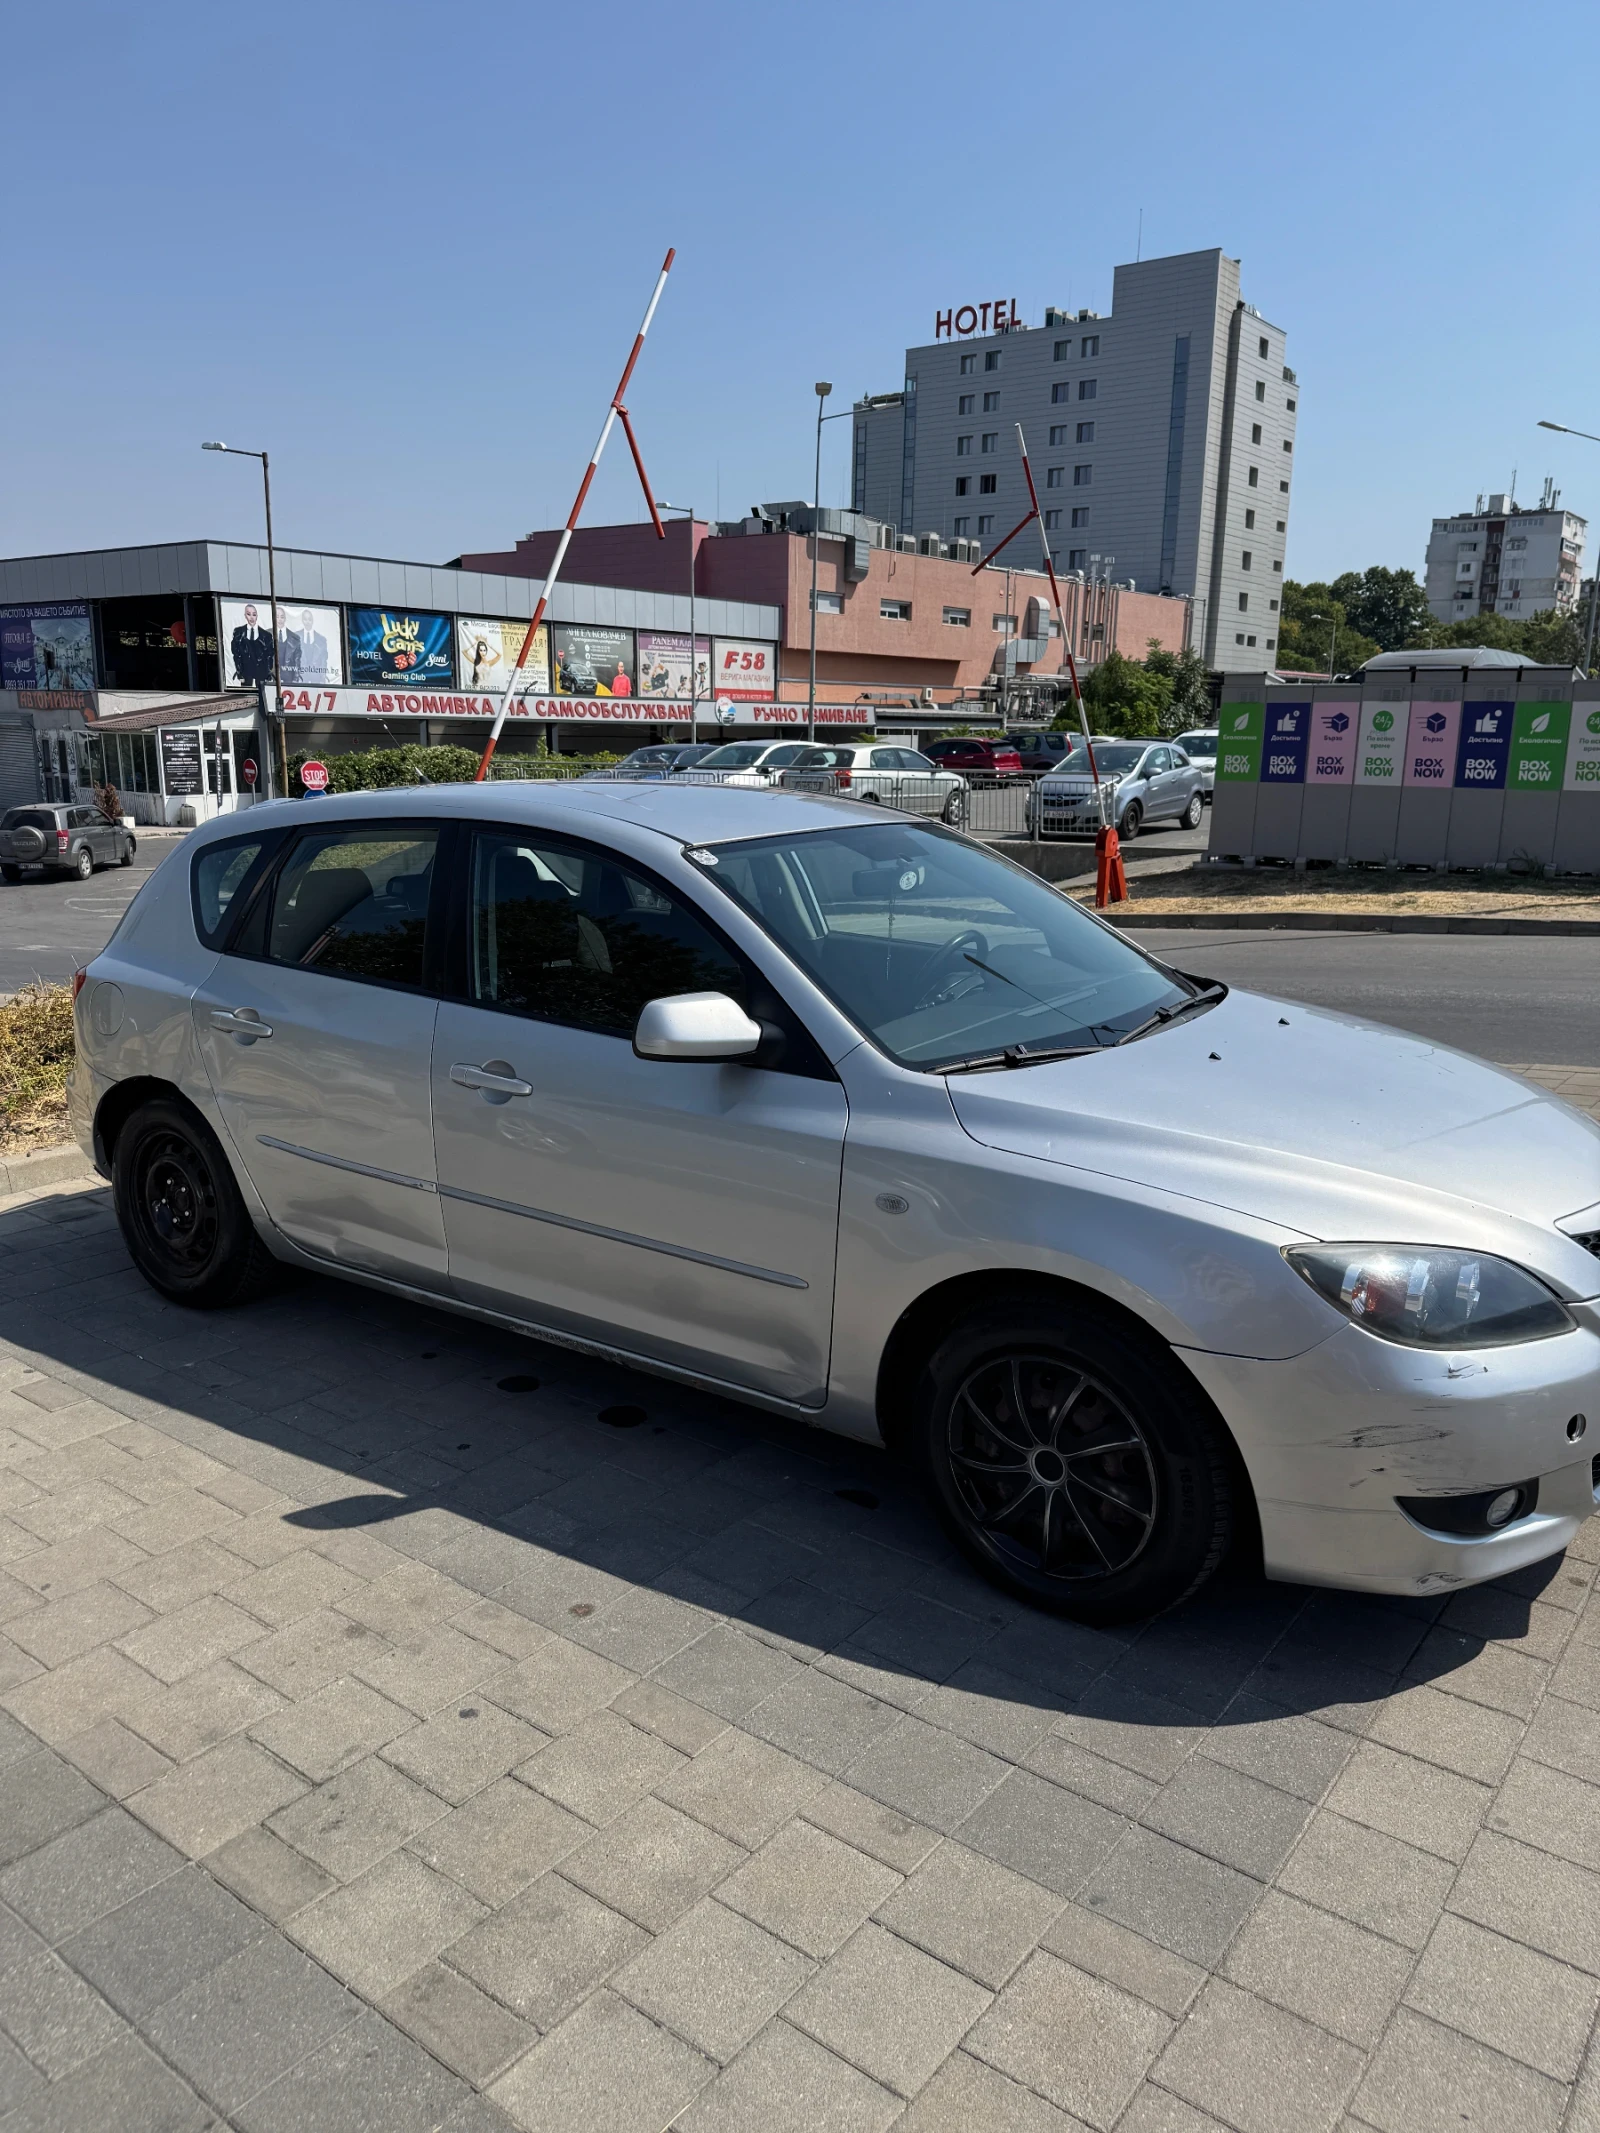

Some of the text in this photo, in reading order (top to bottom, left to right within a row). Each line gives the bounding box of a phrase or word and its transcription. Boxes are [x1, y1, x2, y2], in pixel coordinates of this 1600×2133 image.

[936, 298, 1022, 338] HOTEL
[59, 605, 86, 616] СЪБИТИЕ
[380, 614, 420, 640] Lucky
[566, 628, 627, 641] АНГЕЛ КОВАЧЕВ
[382, 632, 426, 653] Games
[652, 636, 678, 646] PANEM
[357, 650, 382, 660] HOTEL
[425, 653, 450, 667] Sani
[724, 651, 765, 671] F58
[382, 671, 426, 682] Gaming Club
[720, 672, 771, 683] ВЕРИГА МАГАЗИНИ
[20, 692, 85, 708] АВТОМИВКА
[281, 690, 337, 712] 24/7
[367, 693, 495, 716] АВТОМИВКА
[754, 706, 868, 723] РЪЧНО ИЗМИВАНЕ
[1375, 715, 1391, 728] 24/7
[1422, 735, 1443, 743] Бързо
[1468, 736, 1503, 744] Достъпно
[1225, 755, 1249, 764] BOX
[1270, 756, 1296, 765] BOX
[1317, 757, 1343, 765] BOX
[1365, 757, 1392, 766] BOX
[1415, 758, 1443, 767] BOX
[1466, 759, 1496, 769] BOX
[1223, 764, 1250, 773] NOW
[1269, 765, 1297, 774] NOW
[1519, 760, 1550, 770] BOX
[304, 770, 325, 781] STOP
[1316, 766, 1344, 775] NOW
[1364, 767, 1394, 776] NOW
[1413, 768, 1445, 778] NOW
[1464, 769, 1497, 780] NOW
[1518, 771, 1552, 781] NOW
